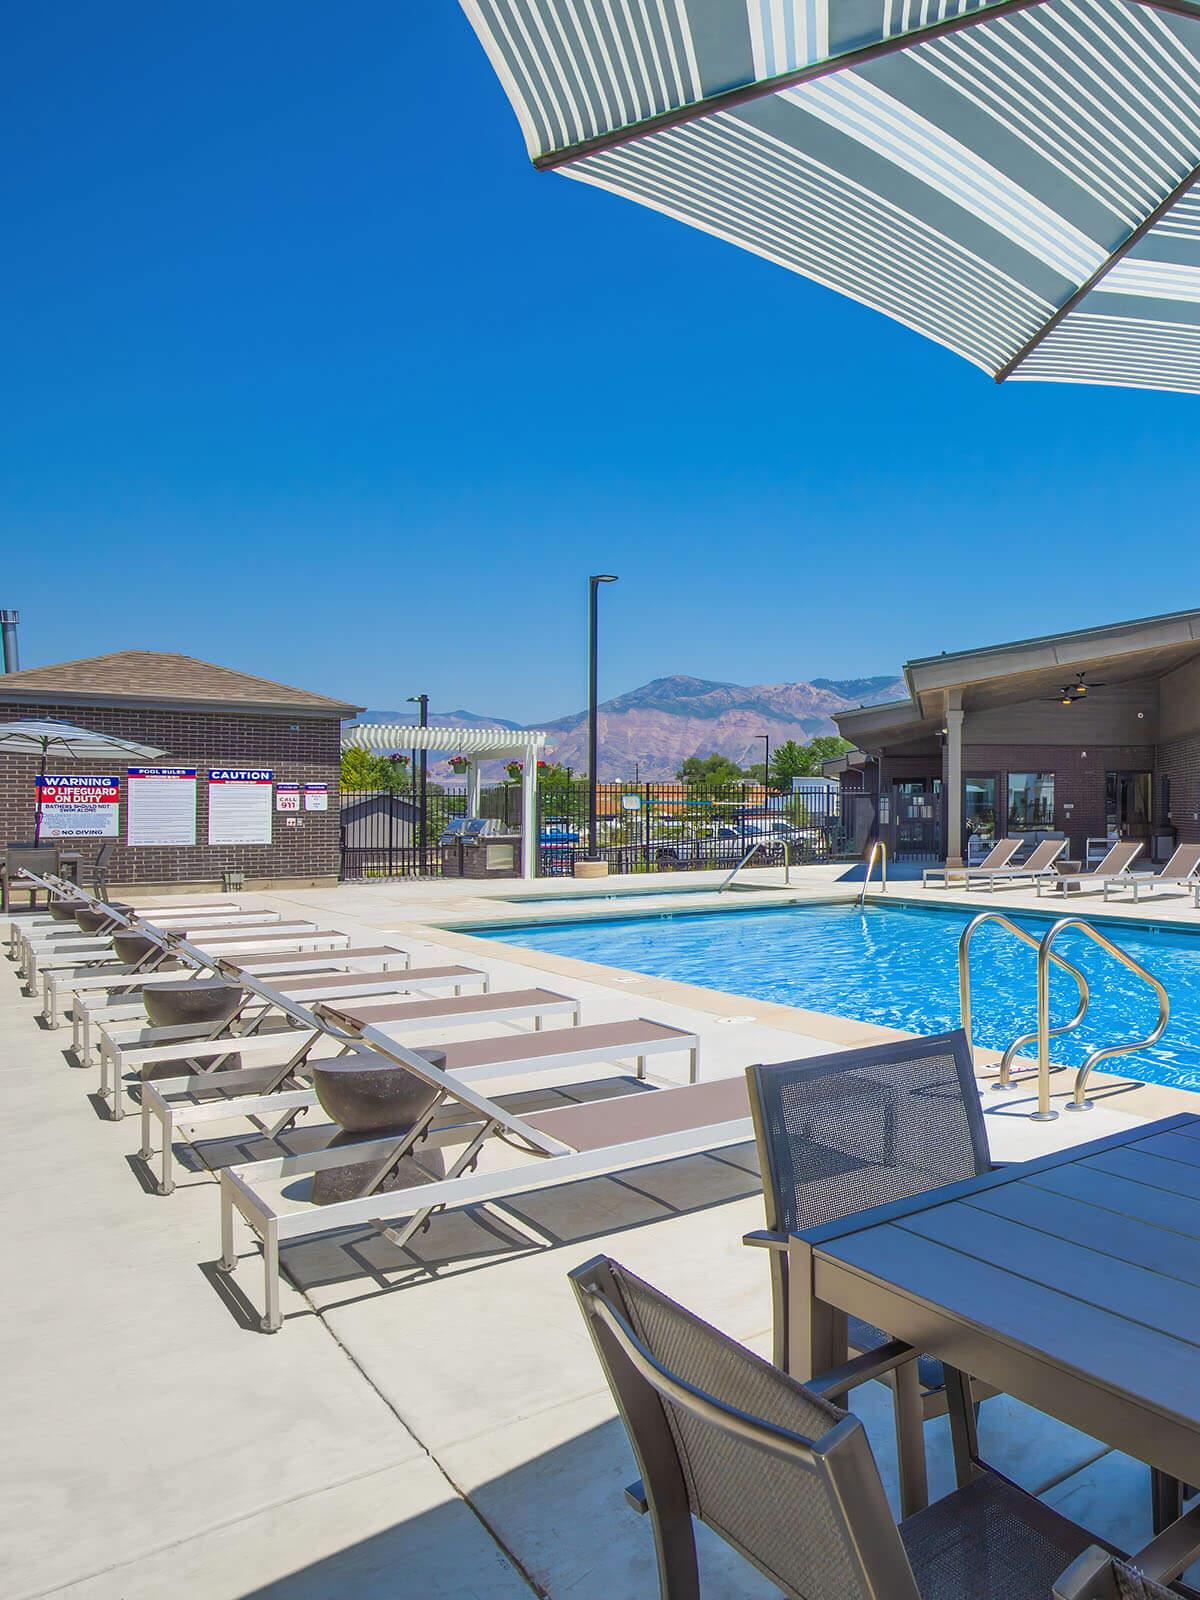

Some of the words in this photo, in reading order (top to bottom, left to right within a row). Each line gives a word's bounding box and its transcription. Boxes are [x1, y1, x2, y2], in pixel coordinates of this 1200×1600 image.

[211, 771, 269, 780] CAUTION
[45, 777, 111, 786] WARNING
[58, 787, 117, 796] LIFEGUARD
[54, 795, 72, 803] ON
[73, 795, 102, 803] DUTY
